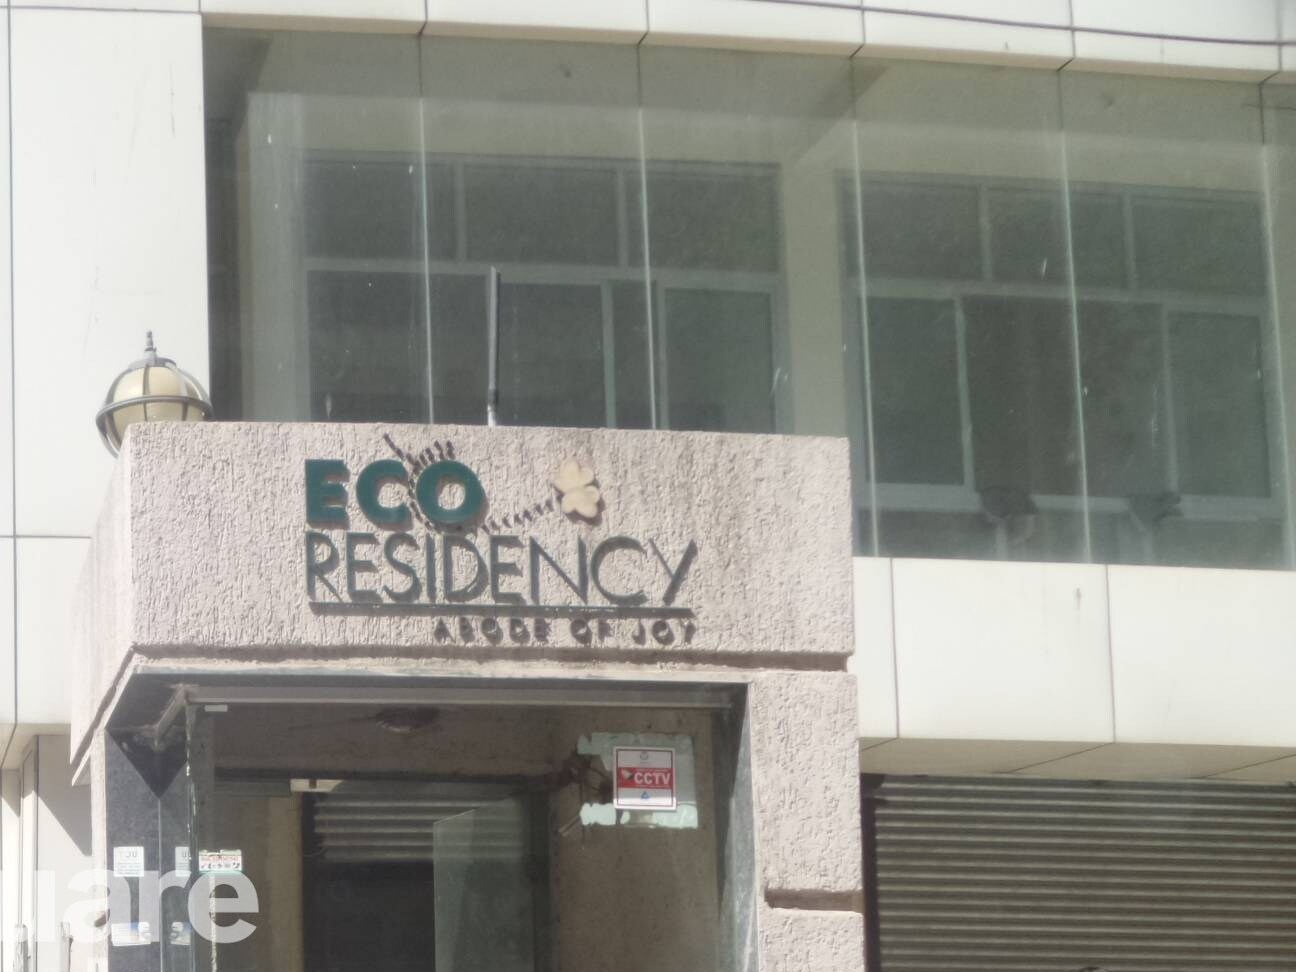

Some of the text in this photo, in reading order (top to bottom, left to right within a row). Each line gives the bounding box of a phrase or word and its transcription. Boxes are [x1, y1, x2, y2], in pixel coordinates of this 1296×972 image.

[305, 459, 487, 527] ECO
[305, 532, 698, 605] RESIDENCY
[433, 617, 697, 647] ABODE OF JOY
[634, 772, 671, 785] CCTV
